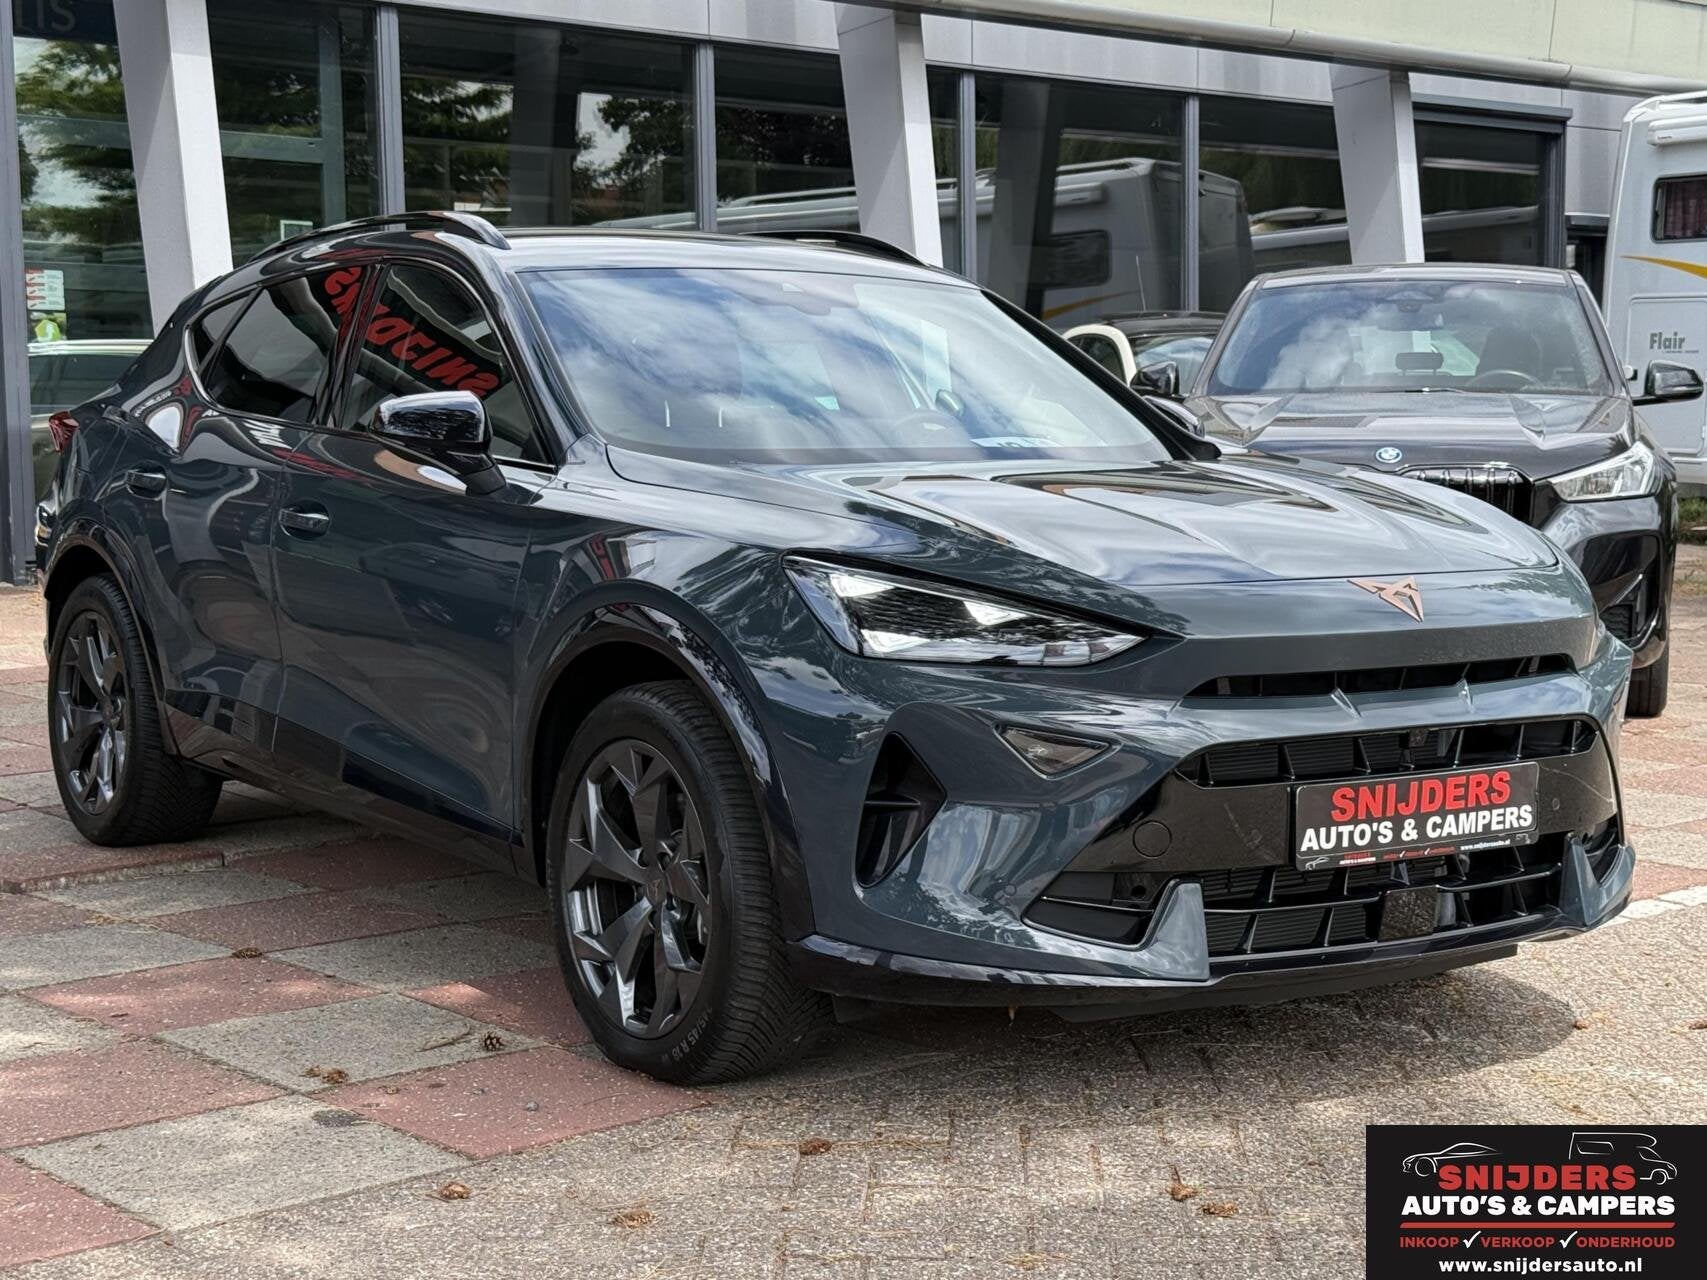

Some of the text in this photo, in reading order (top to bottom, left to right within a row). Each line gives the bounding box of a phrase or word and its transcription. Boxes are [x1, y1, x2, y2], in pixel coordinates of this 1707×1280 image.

[1649, 331, 1686, 350] Flair
[1331, 771, 1511, 822] SNIJDERS
[1300, 804, 1533, 852] AUTO'S & CAMPERS
